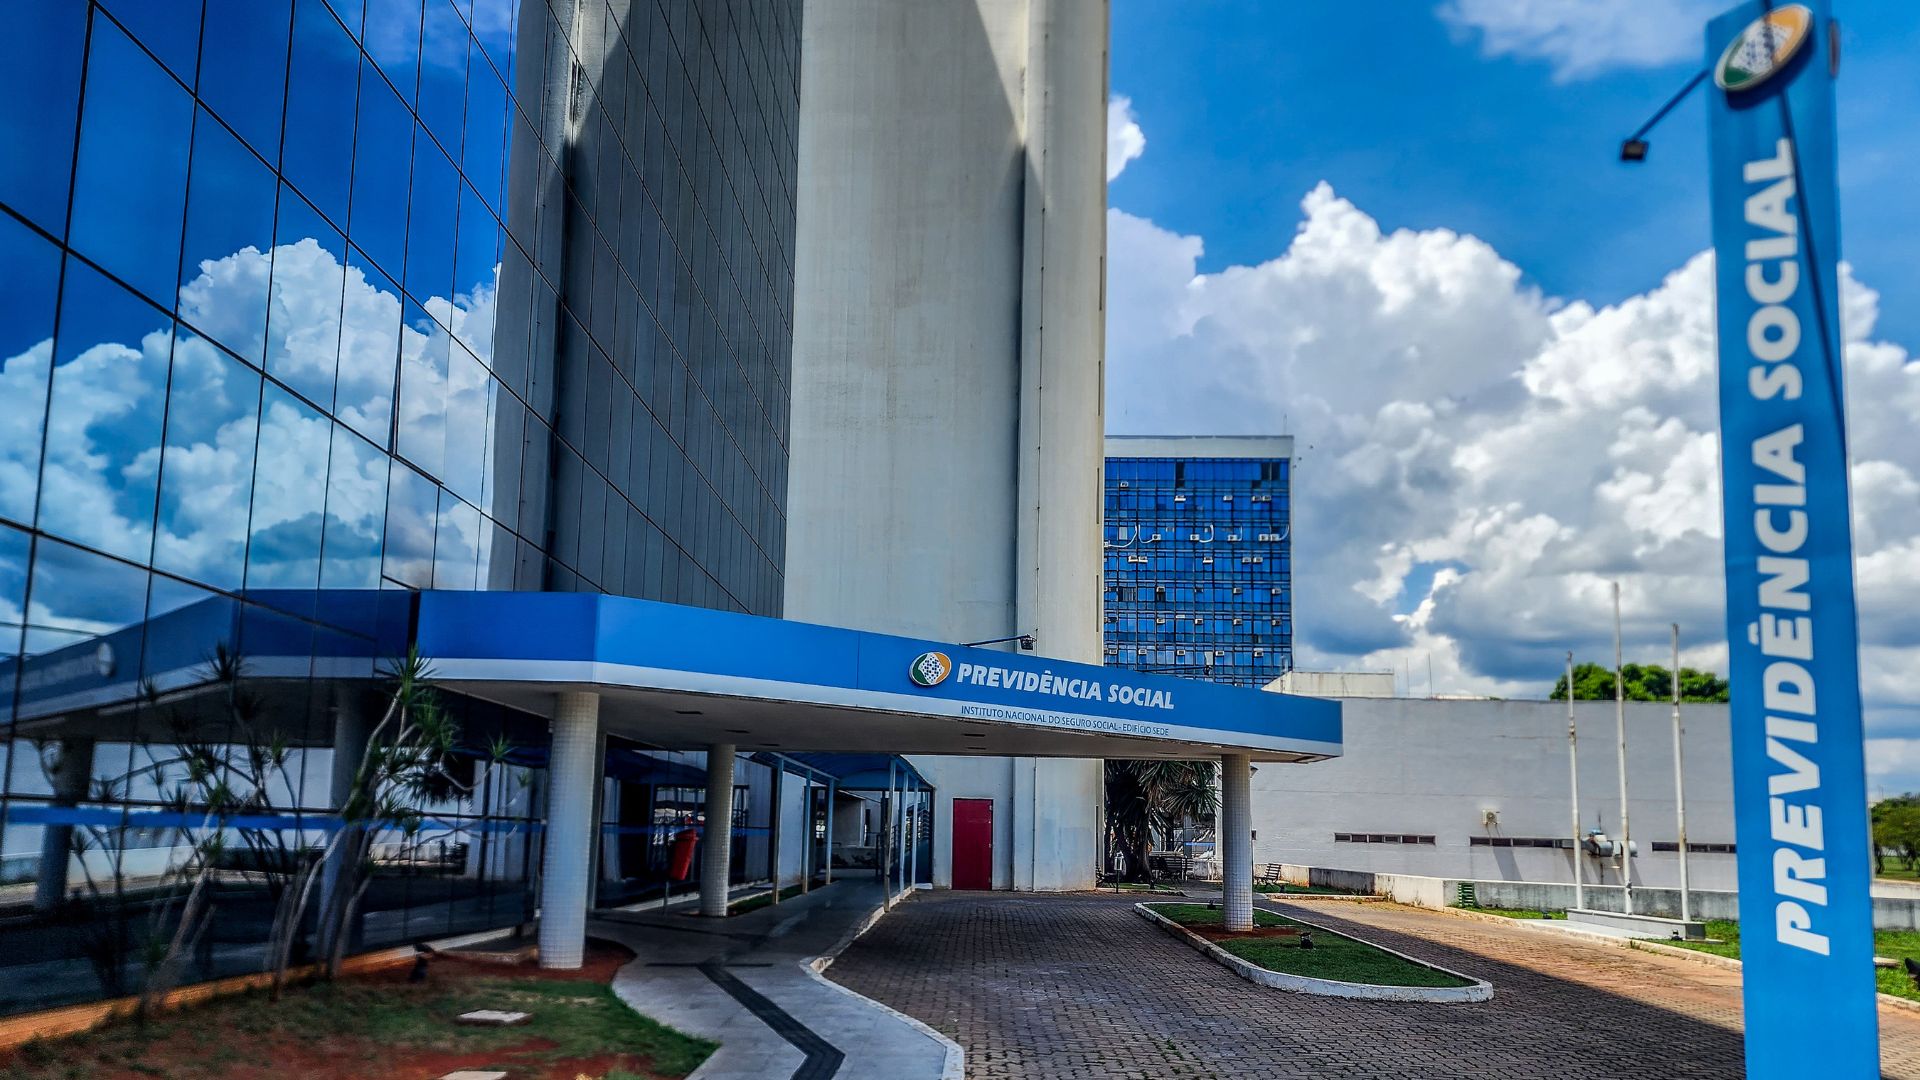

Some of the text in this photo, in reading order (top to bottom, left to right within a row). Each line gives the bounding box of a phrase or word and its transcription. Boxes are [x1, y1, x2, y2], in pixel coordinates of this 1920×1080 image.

[1743, 137, 1830, 957] PREVIDÊNCIA SOCIAL
[956, 663, 1175, 710] PREVIDÊNCIA SOCIAL
[961, 705, 1004, 718] INSTITUTO
[1005, 710, 1047, 723] NACIONAL
[1048, 715, 1061, 725] DO
[1061, 717, 1092, 728] SEGURO
[1092, 720, 1118, 731] SOCIAL
[1122, 722, 1152, 734] EDIFÍCIO
[1152, 727, 1169, 736] SEDE
